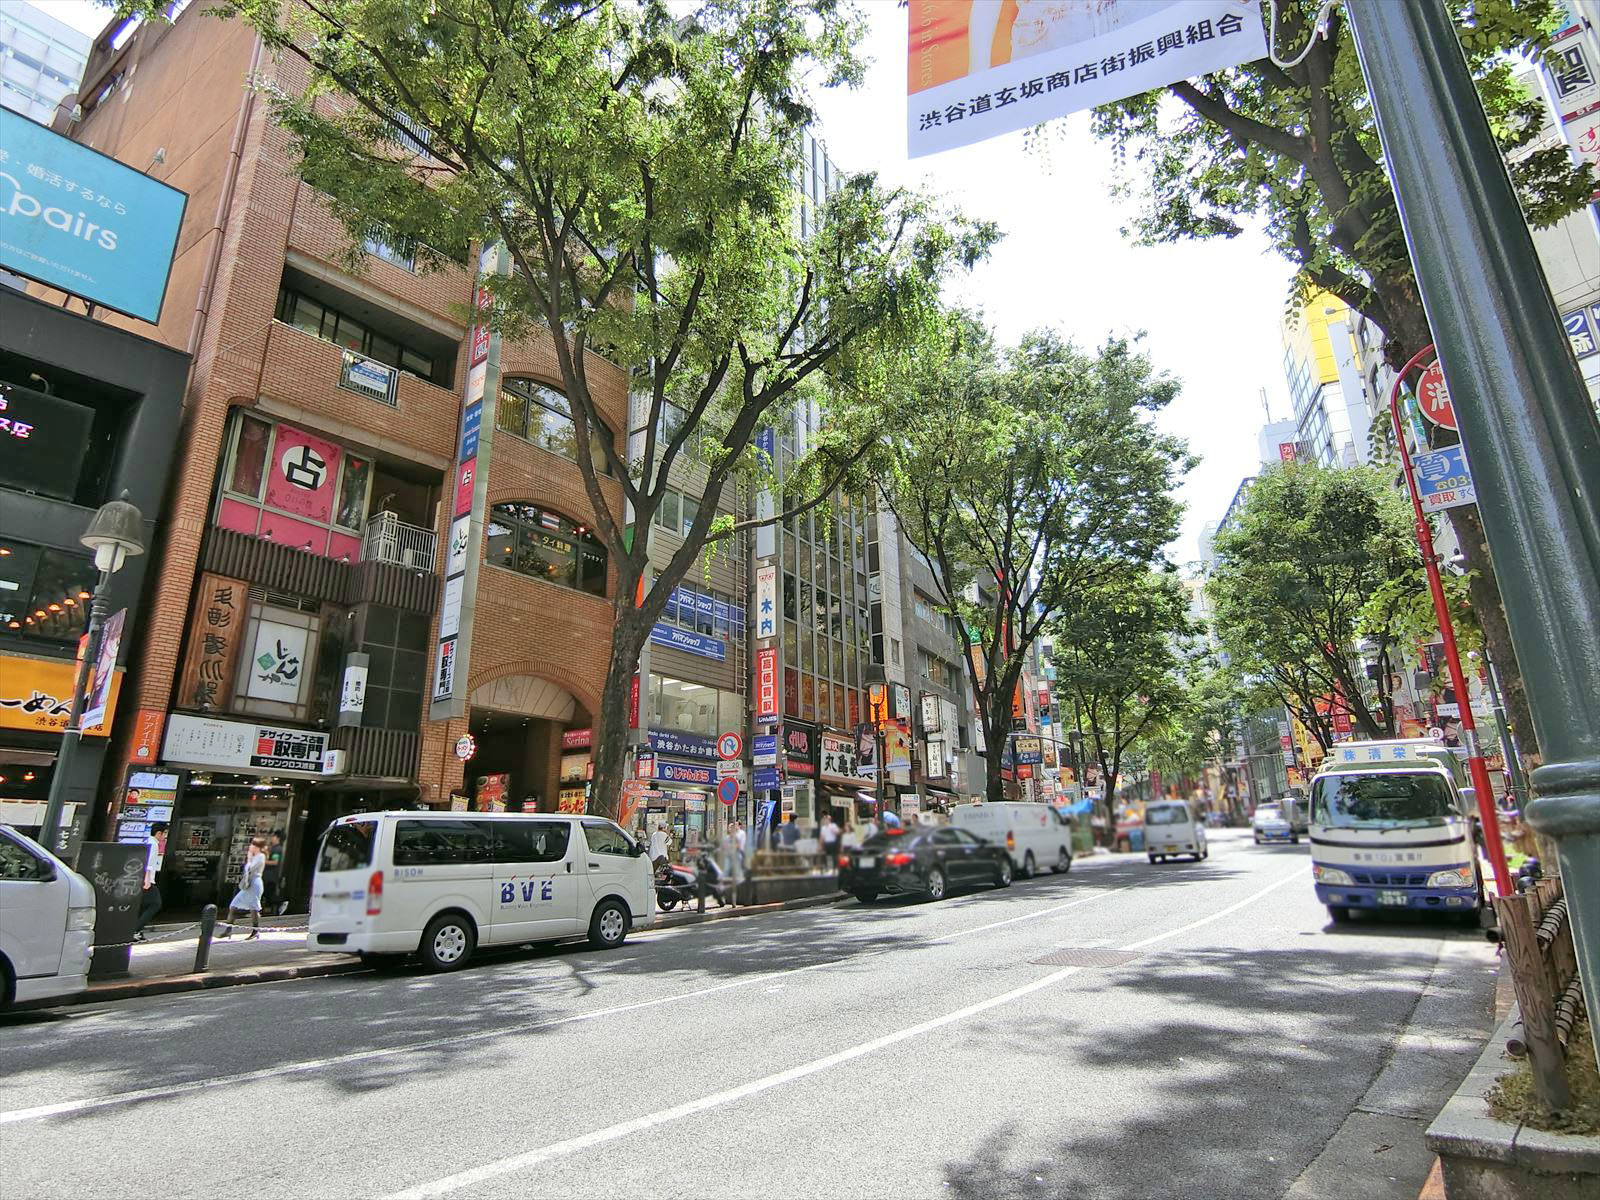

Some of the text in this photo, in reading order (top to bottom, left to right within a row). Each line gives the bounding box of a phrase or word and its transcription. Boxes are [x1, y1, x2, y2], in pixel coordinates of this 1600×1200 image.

[919, 12, 1244, 131] 渋谷道玄坂商店街振興組合
[9, 191, 118, 251] pairs
[286, 445, 326, 491] 占
[761, 598, 773, 635] 木内
[257, 738, 323, 760] 買取専門
[1431, 729, 1441, 738] 8
